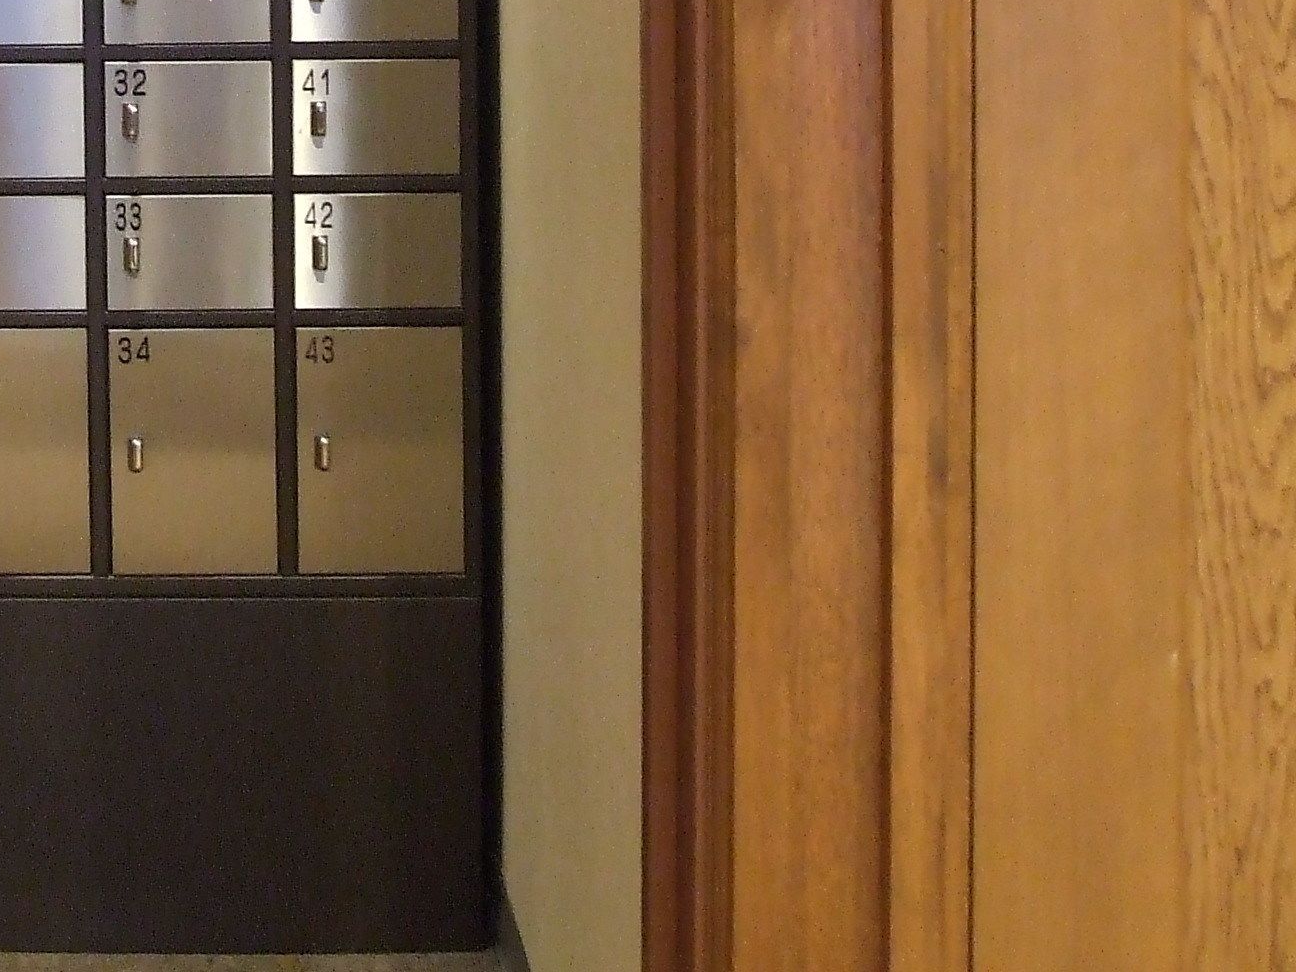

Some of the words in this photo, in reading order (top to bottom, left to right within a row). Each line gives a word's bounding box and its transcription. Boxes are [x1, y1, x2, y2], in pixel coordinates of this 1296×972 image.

[115, 69, 146, 96] 32
[302, 68, 330, 95] 41
[115, 202, 141, 231] 33
[304, 202, 333, 228] 42
[118, 336, 150, 364] 34
[306, 335, 336, 362] 43
